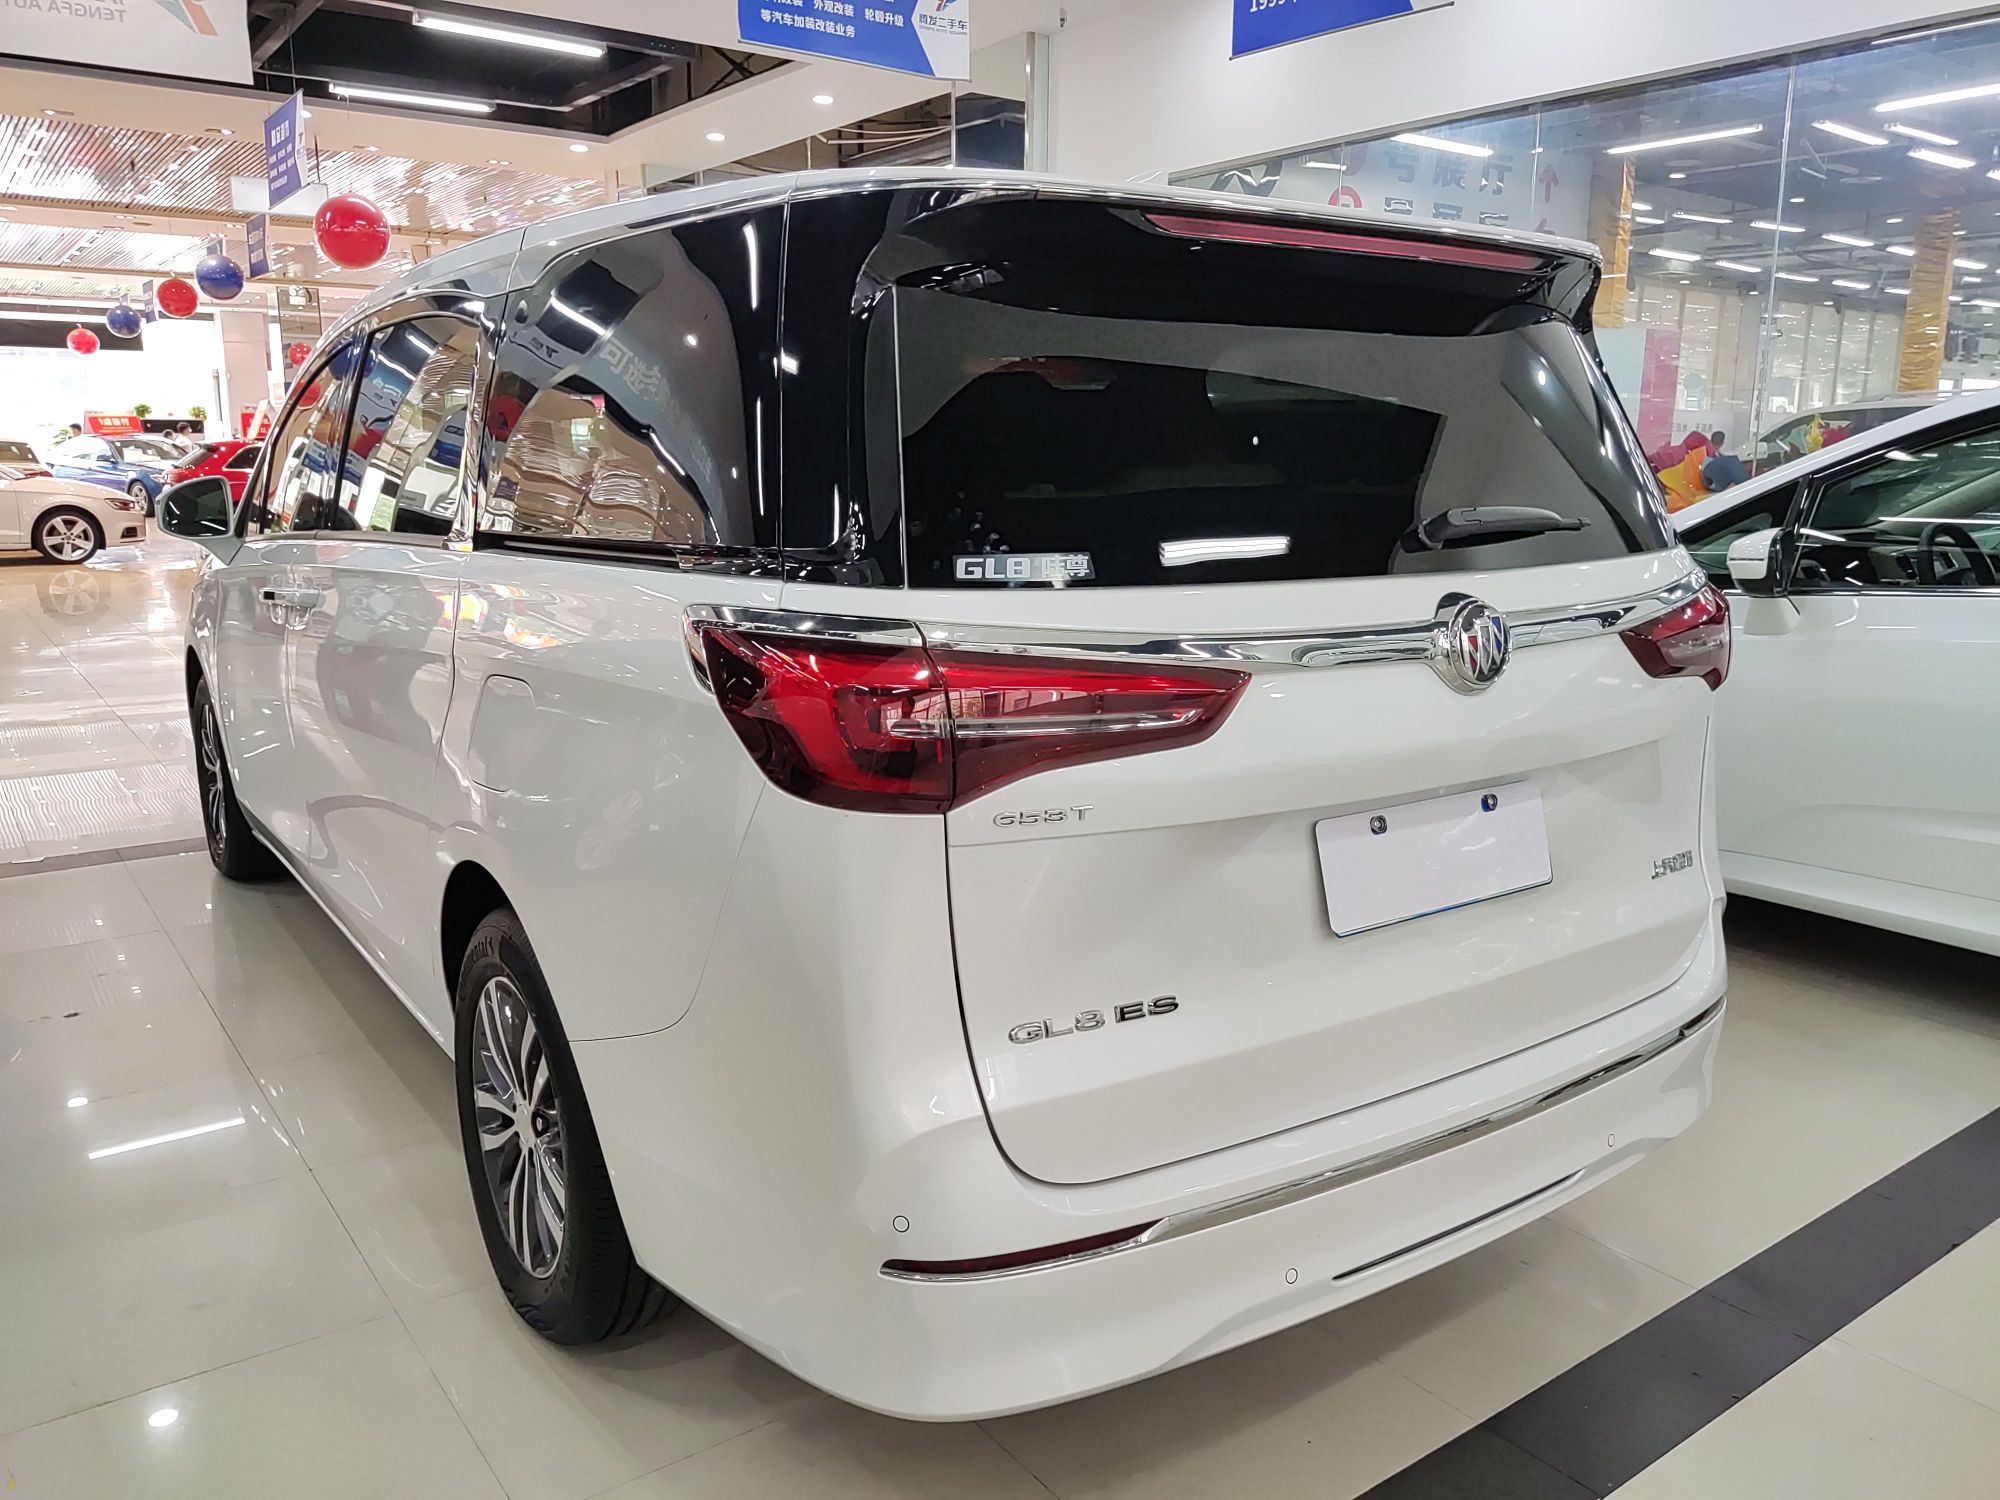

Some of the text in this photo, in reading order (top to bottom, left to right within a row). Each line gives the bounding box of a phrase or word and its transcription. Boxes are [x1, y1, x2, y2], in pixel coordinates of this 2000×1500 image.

[760, 8, 856, 38] 等汽车加装改装业务
[813, 0, 855, 17] 外观改装
[864, 7, 905, 28] 轮毂升级
[956, 557, 1031, 579] GL8
[1008, 994, 1180, 1046] GL8 ES
